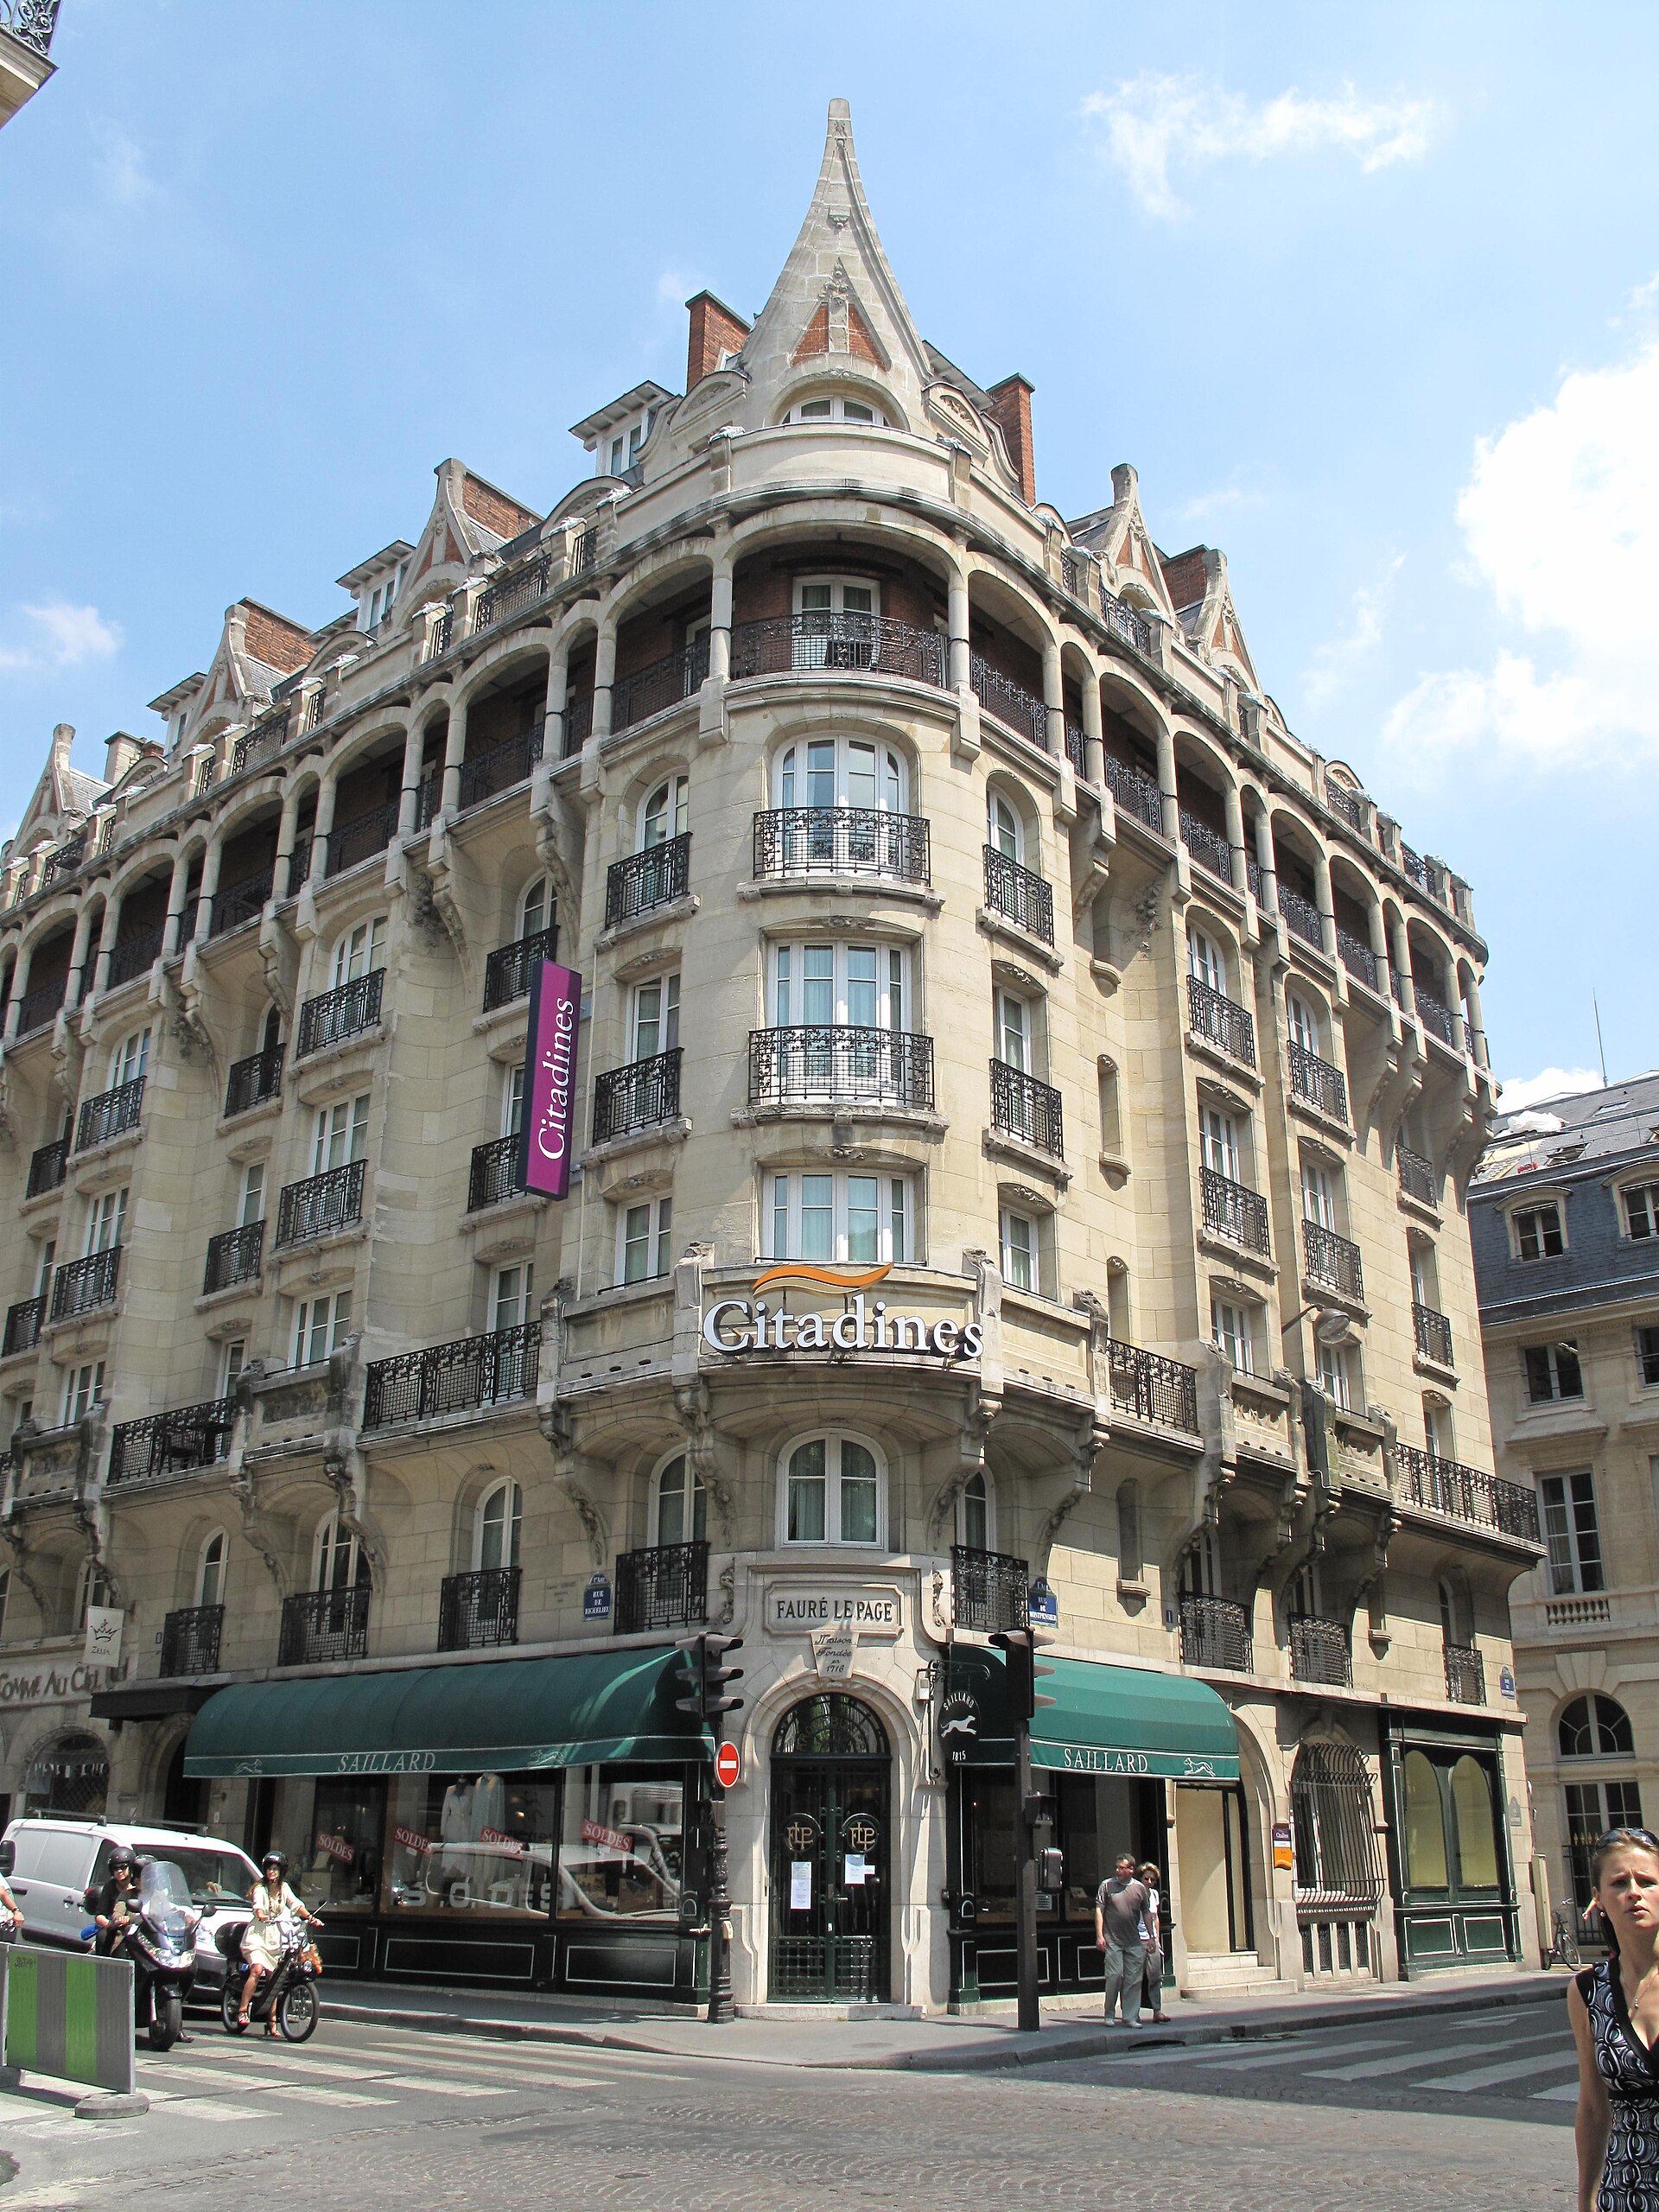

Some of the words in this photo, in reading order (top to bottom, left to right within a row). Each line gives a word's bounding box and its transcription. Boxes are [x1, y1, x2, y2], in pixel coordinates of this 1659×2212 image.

[537, 997, 575, 1160] Citadines
[702, 1293, 984, 1360] Citadines
[584, 1606, 610, 1615] RICHELIEU
[777, 1597, 829, 1618] FAURÉ
[834, 1600, 853, 1619] LE
[856, 1600, 893, 1623] PAGE
[815, 1634, 852, 1645] Maison
[816, 1647, 852, 1657] Fondée
[44, 1669, 68, 1696] AU
[944, 1692, 975, 1711] SAILLARD
[337, 1751, 435, 1772] SAILLARD
[952, 1750, 966, 1761] 1815
[1064, 1747, 1148, 1773] SAILLARD
[318, 1834, 353, 1861] SOLDES
[395, 1827, 432, 1854] SOLDES
[482, 1828, 523, 1855] SOLDES
[584, 1821, 631, 1852] SOLDES
